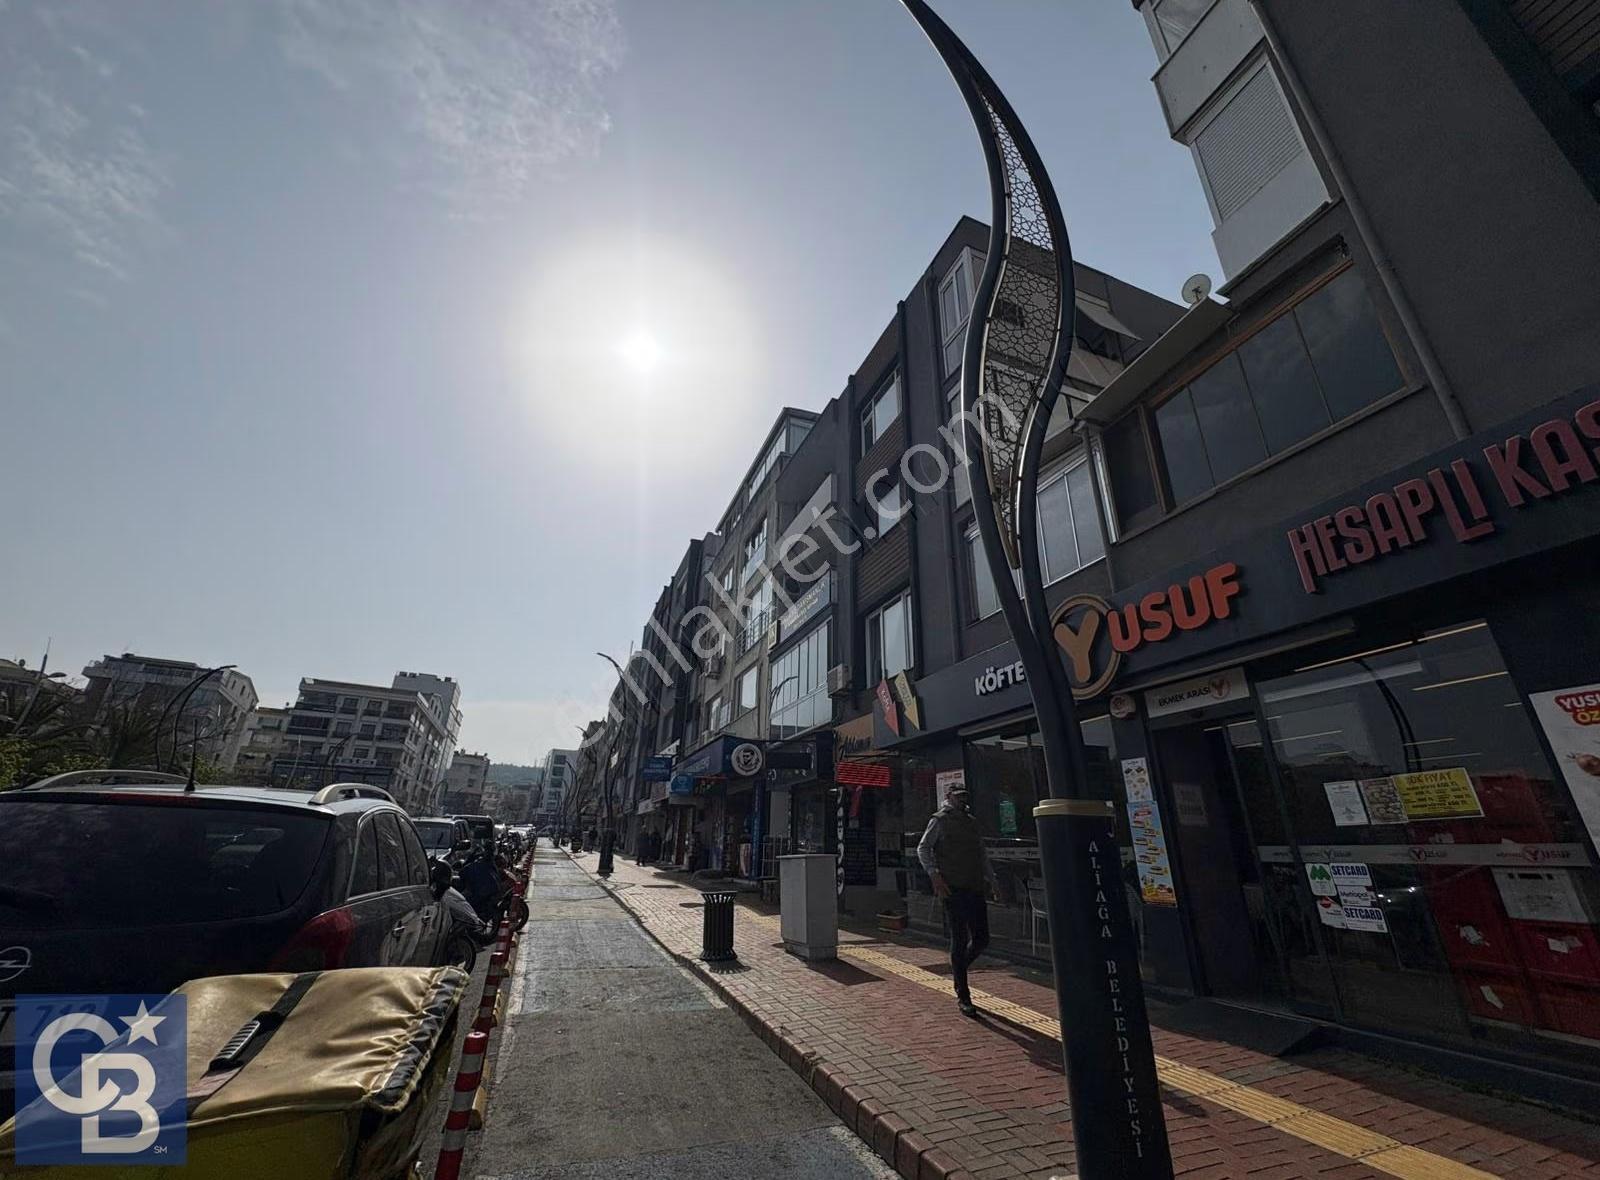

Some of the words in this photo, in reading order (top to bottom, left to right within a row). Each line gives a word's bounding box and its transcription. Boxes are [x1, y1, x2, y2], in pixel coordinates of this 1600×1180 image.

[1287, 458, 1495, 595] HESAPLI
[1053, 562, 1240, 683] YUSUF
[974, 660, 1025, 696] KÖFTE
[1158, 693, 1185, 707] EKMEK
[1187, 686, 1212, 700] ARASI
[1331, 865, 1368, 876] SETCARD
[1344, 907, 1383, 920] SETCARD
[1088, 839, 1112, 938] ALİAĞA
[1105, 959, 1143, 1159] BELEDİYESİ
